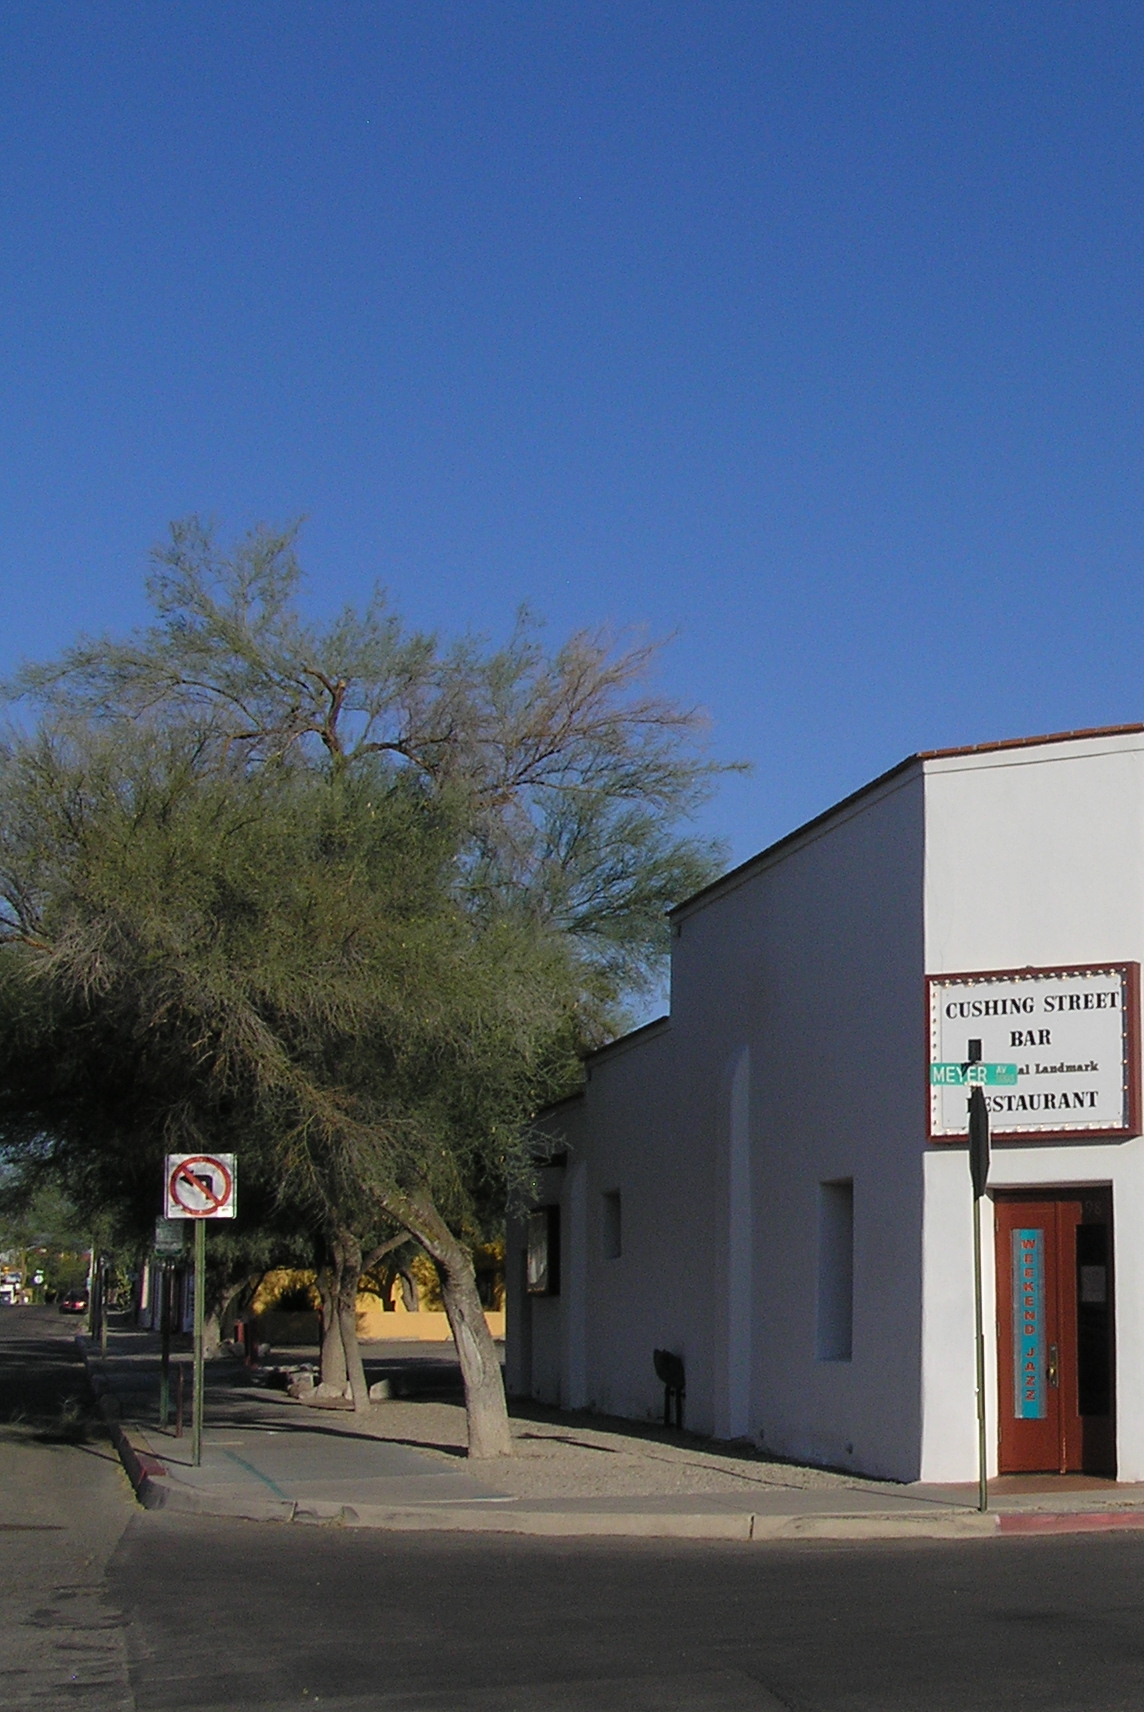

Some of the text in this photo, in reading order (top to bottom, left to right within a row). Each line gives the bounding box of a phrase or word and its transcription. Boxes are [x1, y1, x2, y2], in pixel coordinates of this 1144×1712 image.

[946, 992, 1119, 1019] CUSHING STREET
[1009, 1029, 1052, 1047] BAR
[933, 1066, 987, 1082] MEYER
[1035, 1060, 1099, 1075] Landmark
[1021, 1239, 1036, 1400] WEEKEND JAZZ
